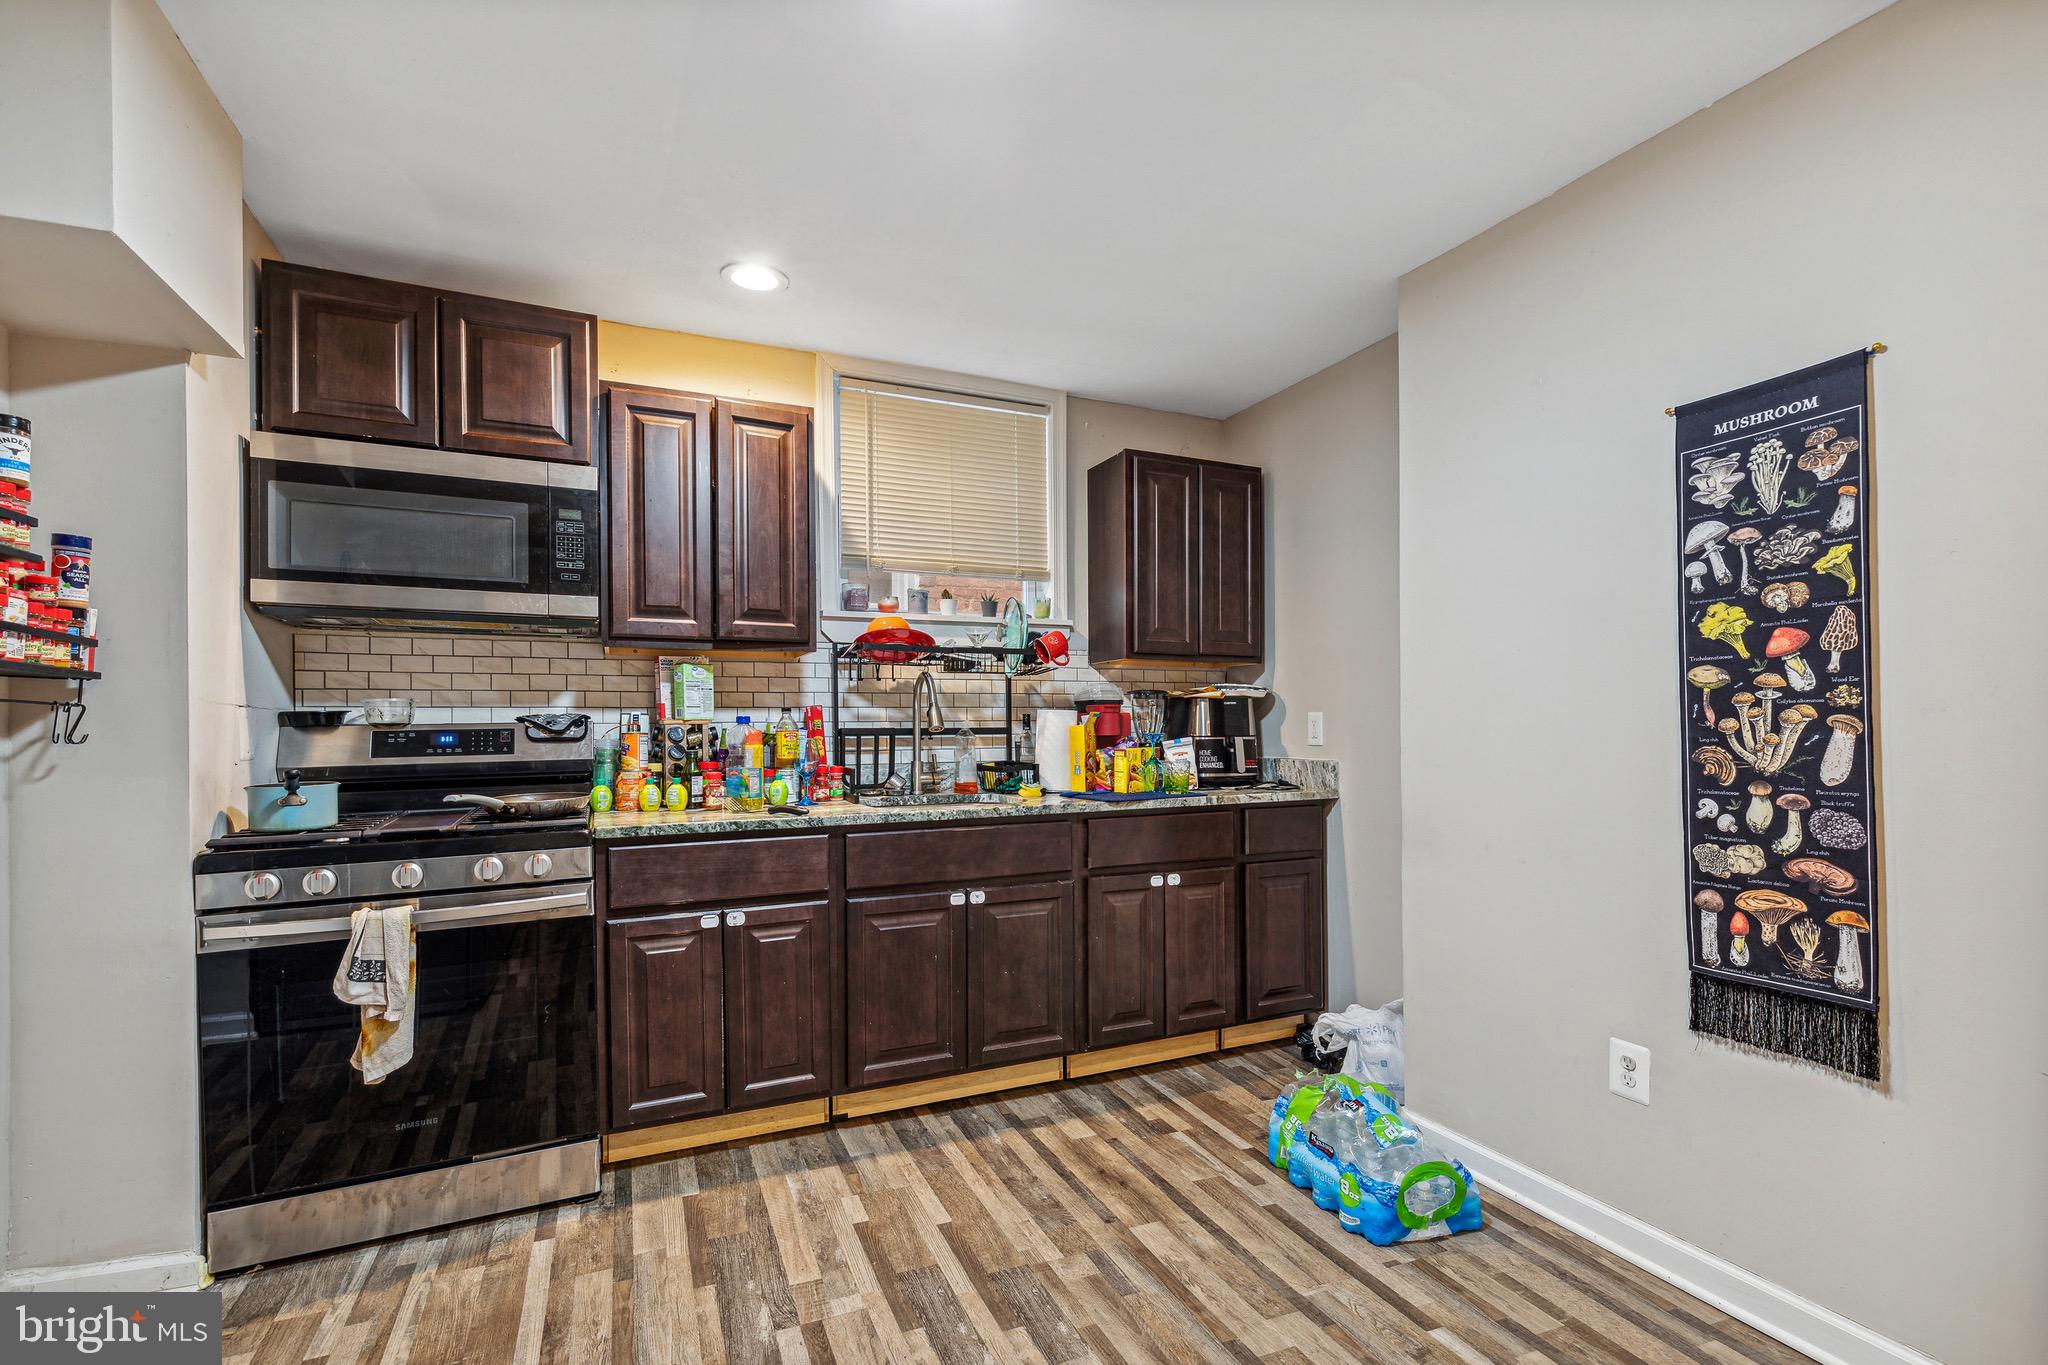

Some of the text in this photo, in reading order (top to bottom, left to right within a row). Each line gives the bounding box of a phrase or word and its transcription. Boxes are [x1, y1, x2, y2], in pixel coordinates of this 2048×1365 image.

[1713, 395, 1820, 436] MUSHROOM
[395, 1117, 439, 1131] SAMSUNG
[1313, 1167, 1335, 1187] Water
[1340, 1178, 1360, 1202] 8 oz
